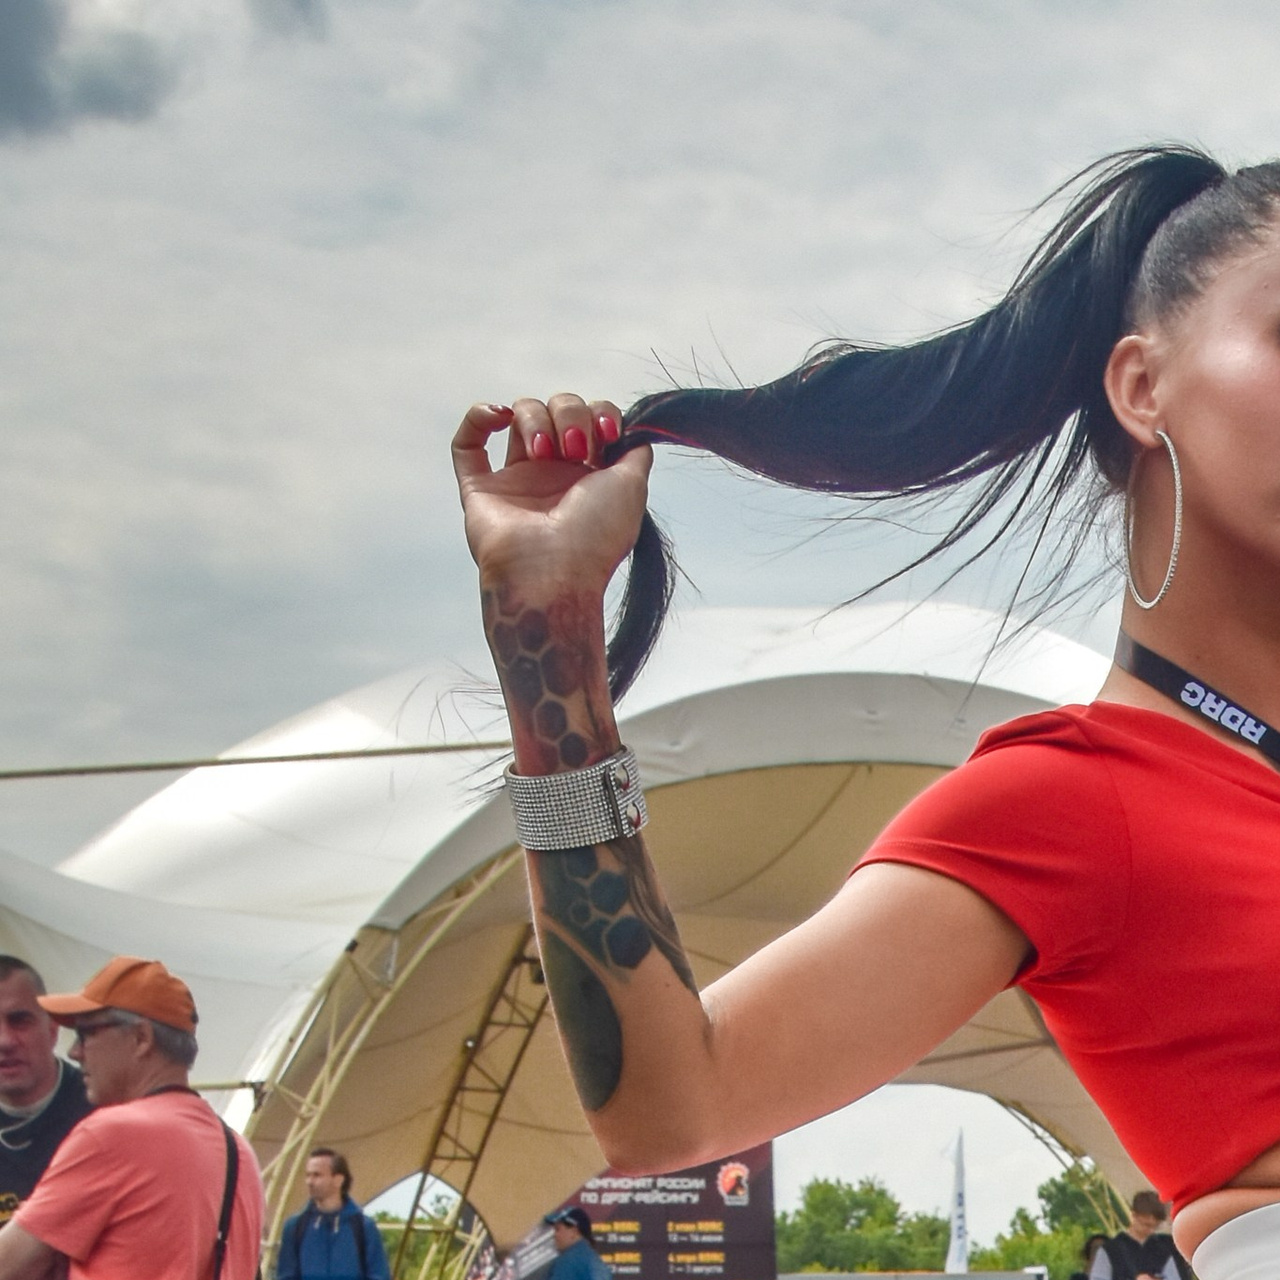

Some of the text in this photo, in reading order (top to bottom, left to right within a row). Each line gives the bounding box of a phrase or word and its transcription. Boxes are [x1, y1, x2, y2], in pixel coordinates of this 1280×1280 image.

[1181, 682, 1267, 745] RDRC
[656, 1177, 706, 1190] РОССИИ
[580, 1191, 599, 1204] ПО
